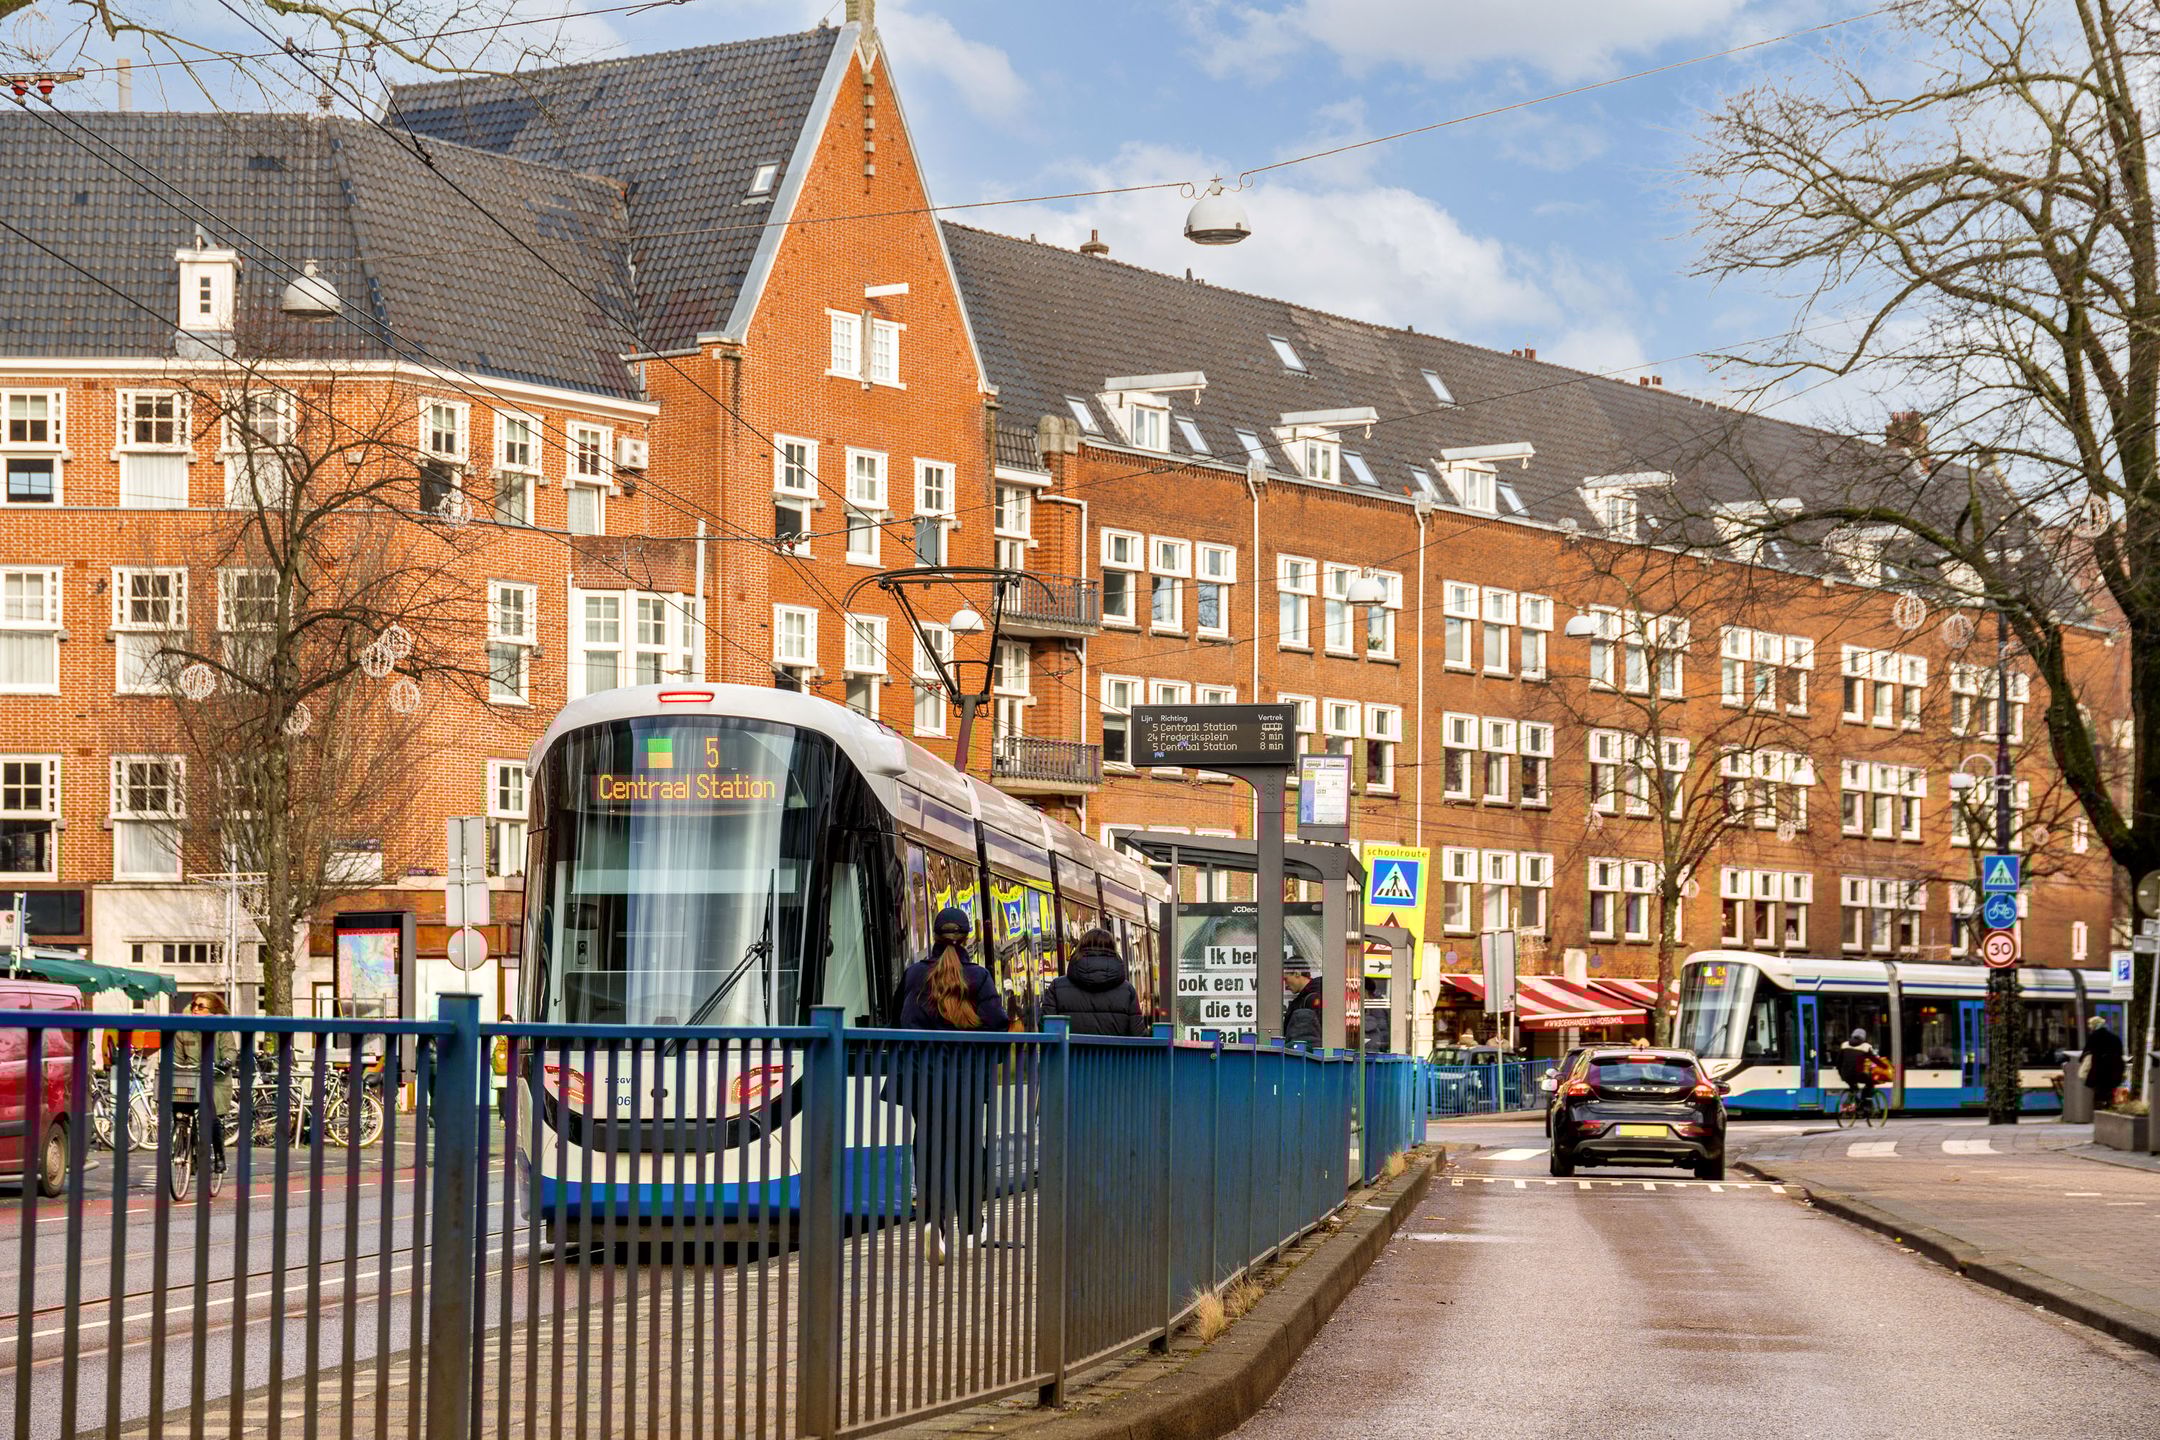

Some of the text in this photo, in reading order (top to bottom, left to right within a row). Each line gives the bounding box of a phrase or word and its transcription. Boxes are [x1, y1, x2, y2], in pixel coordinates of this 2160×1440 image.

[1152, 723, 1237, 732] 5 Centraal Station
[1147, 732, 1284, 742] 24 Frederiksplein 3 min
[706, 737, 719, 769] 5
[1152, 743, 1159, 751] 5
[1203, 742, 1237, 751] Station
[1260, 742, 1266, 750] 8
[1269, 742, 1284, 750] min
[599, 774, 775, 800] Centraal Station
[1367, 848, 1427, 858] schoolroute
[1211, 948, 1226, 964] Ik
[1990, 943, 2012, 956] 30
[1179, 975, 1208, 992] ook
[1214, 978, 1243, 991] een
[1205, 1001, 1253, 1018] die te
